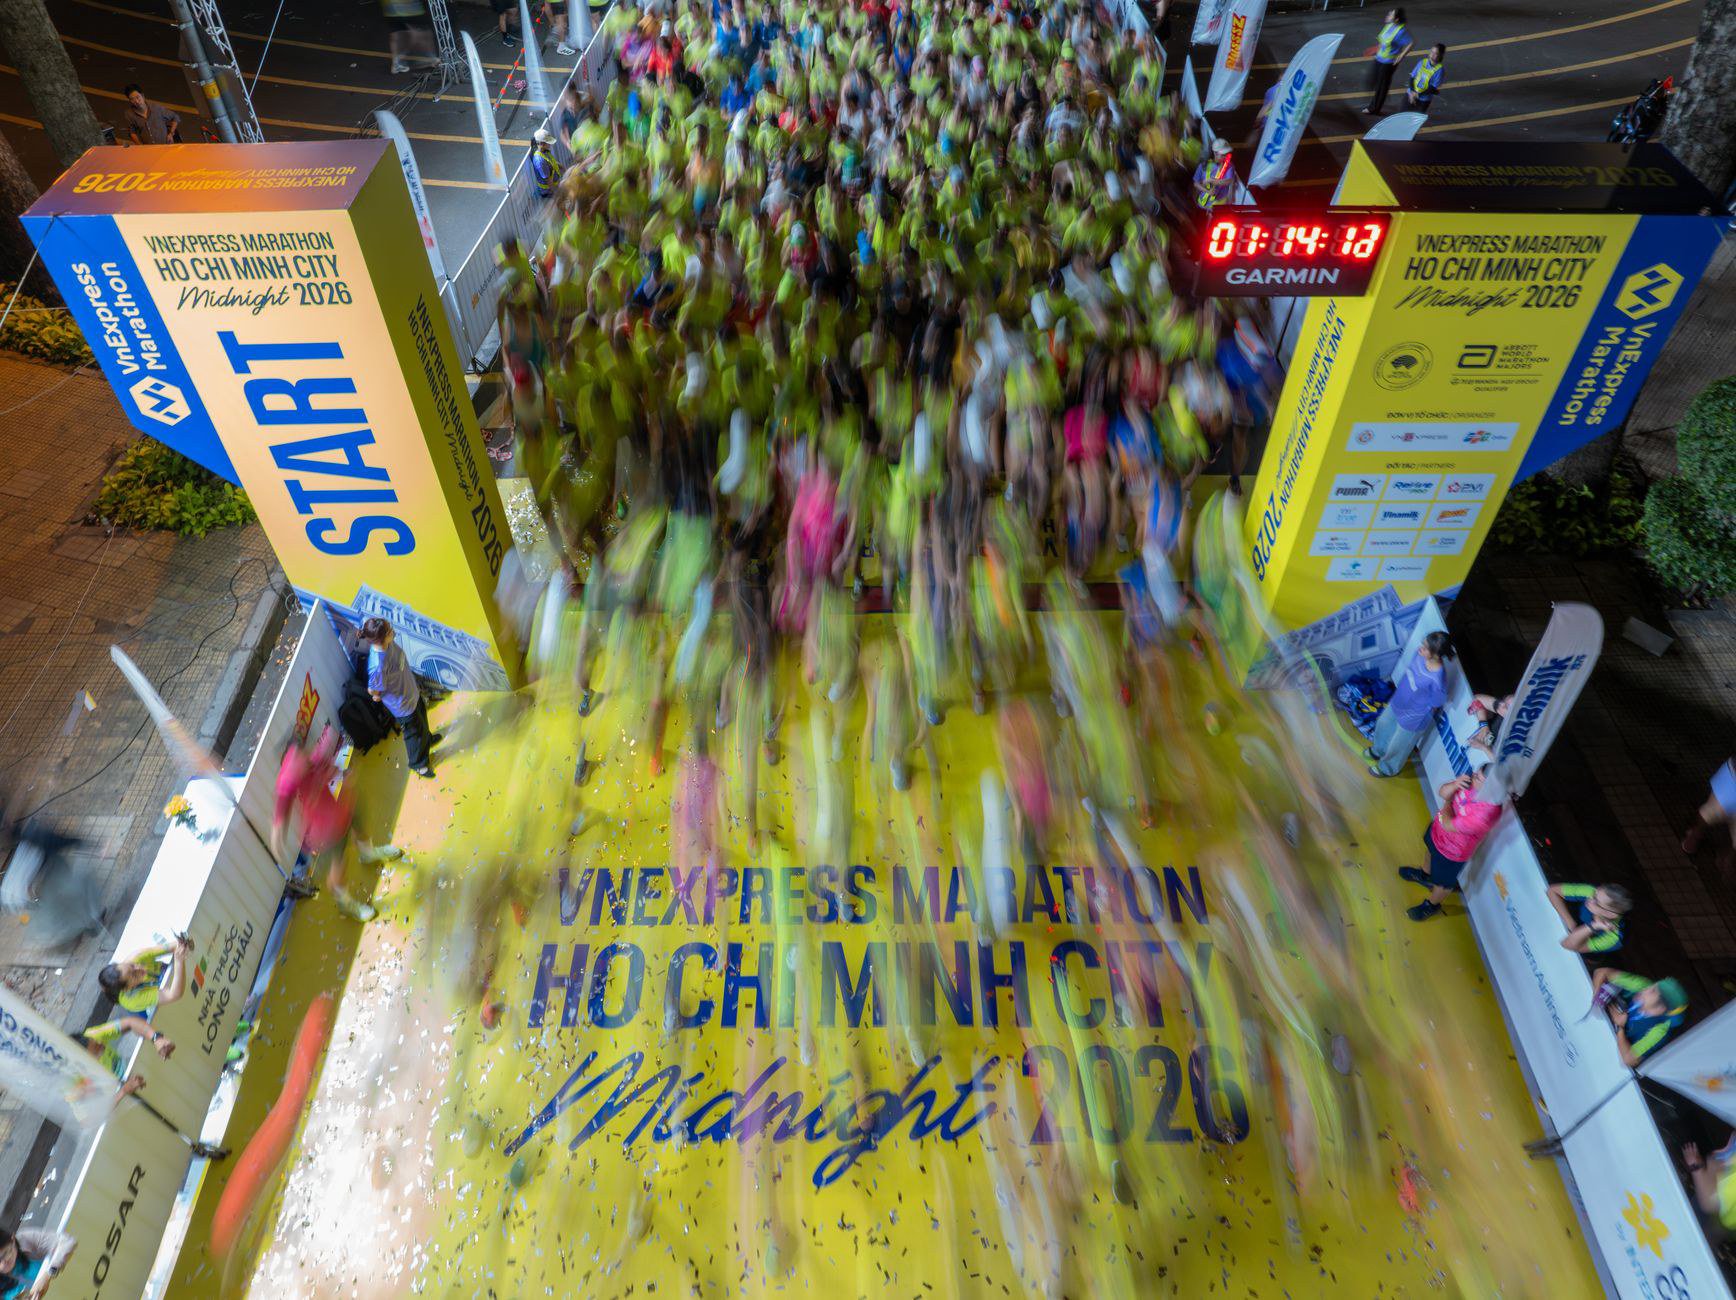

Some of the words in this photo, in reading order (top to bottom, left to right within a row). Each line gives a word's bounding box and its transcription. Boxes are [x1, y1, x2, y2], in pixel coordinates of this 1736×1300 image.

[72, 172, 168, 193] 2026
[159, 178, 250, 191] MARATHON
[253, 175, 347, 190] VNEXPRESS
[277, 167, 312, 177] MINH
[1586, 166, 1678, 187] 2026
[143, 234, 241, 254] VNEXPRESS
[240, 231, 336, 252] MARATHON
[154, 257, 190, 281] HO
[190, 256, 232, 281] CHI
[231, 255, 293, 280] MINH
[293, 254, 340, 278] CITY
[1404, 257, 1438, 281] HO
[1440, 257, 1482, 281] CHI
[1481, 257, 1543, 282] MINH
[1542, 257, 1595, 282] CITY
[1415, 234, 1511, 254] VNEXPRESS
[1510, 235, 1608, 254] MARATHON
[177, 284, 291, 315] Midnight
[293, 281, 353, 306] 2026
[1225, 268, 1340, 285] GARMIN
[1394, 285, 1524, 316] Midnight
[1521, 284, 1583, 309] 2026
[71, 262, 141, 375] VnExpress
[101, 262, 167, 371] Marathon
[407, 310, 419, 337] HO
[415, 333, 429, 364] CHI
[423, 360, 441, 404] MINH
[435, 398, 451, 431] CITY
[1308, 316, 1347, 422] VNEXPRESS
[1558, 327, 1627, 426] Marathon
[1585, 322, 1658, 425] VnExpress
[216, 330, 416, 556] START
[415, 291, 453, 404] VNEXPRESS
[448, 397, 480, 490] MARATHON
[471, 487, 503, 577] 2026
[1279, 416, 1313, 512] MARATHON
[1335, 487, 1369, 496] PUMA
[1252, 490, 1283, 582] 2026
[559, 864, 877, 927] VNEXPRESS
[893, 865, 1209, 926] MARATHON
[201, 987, 232, 1056] LONG
[227, 920, 254, 984] CHÂU
[527, 942, 645, 1029] HO
[663, 941, 799, 1029] CHI
[818, 940, 1032, 1029] MINH
[1050, 939, 1214, 1029] CITY
[502, 1050, 1001, 1191] Midnight
[1021, 1044, 1251, 1146] 2026
